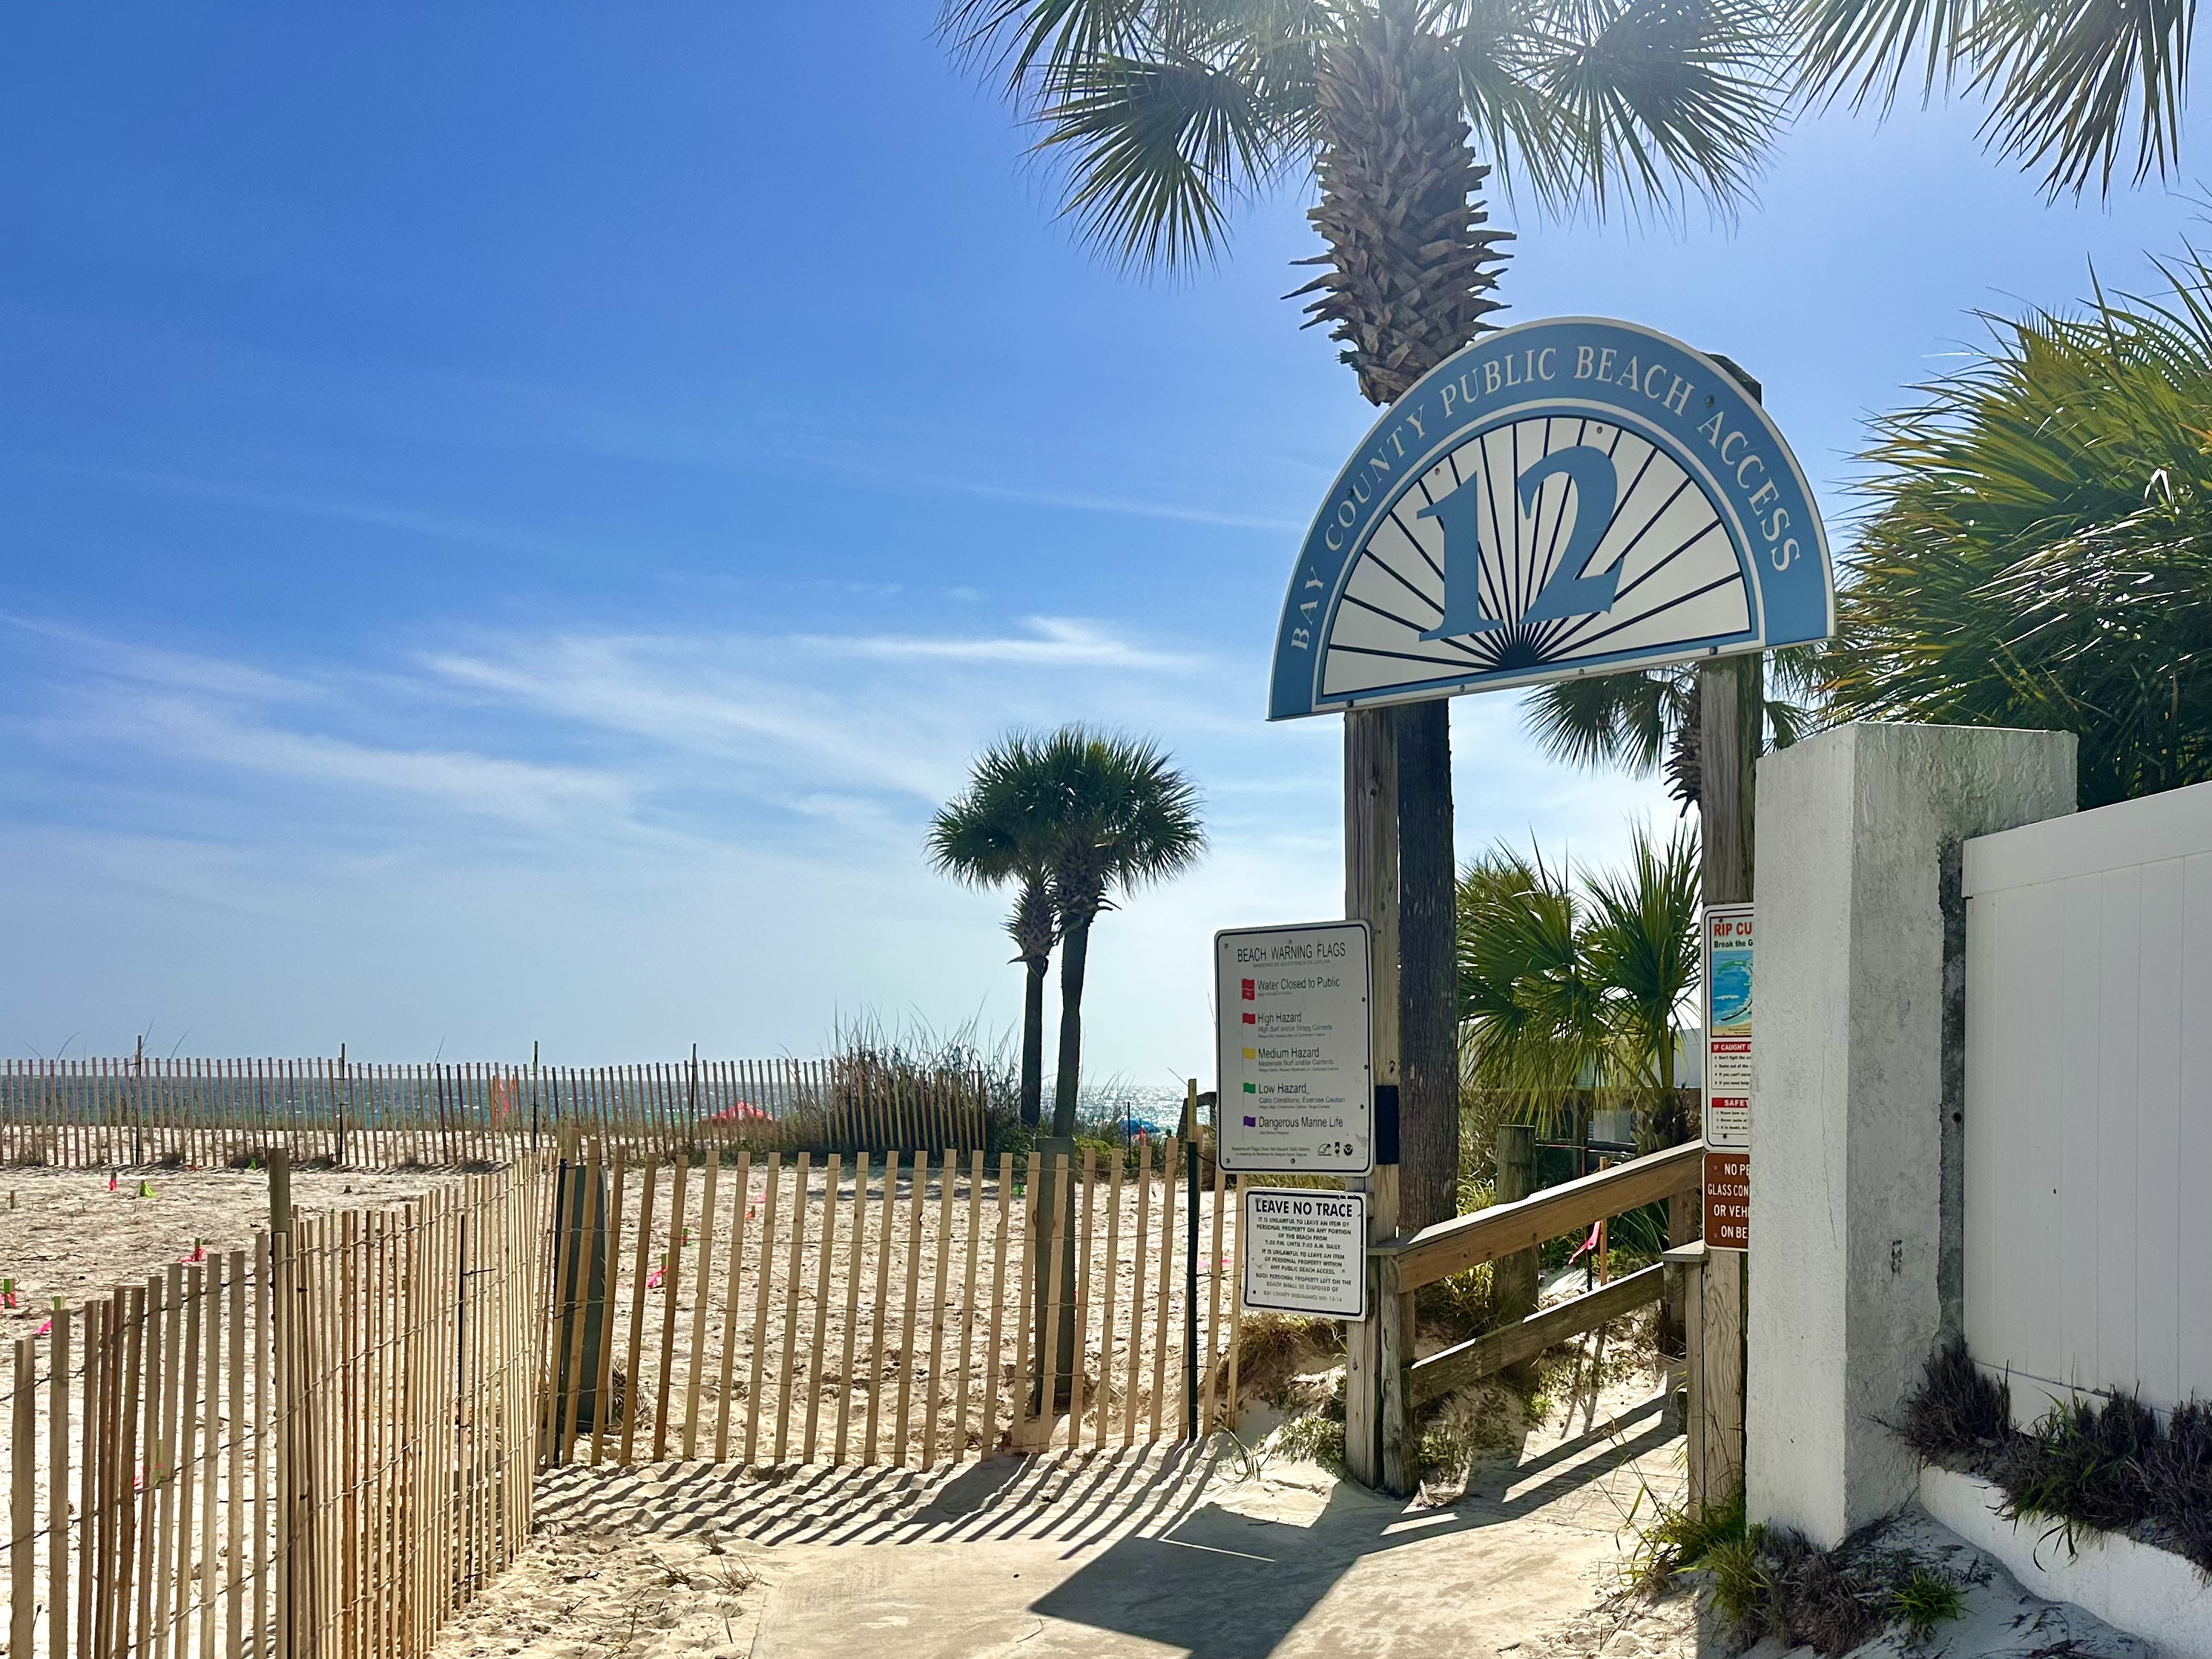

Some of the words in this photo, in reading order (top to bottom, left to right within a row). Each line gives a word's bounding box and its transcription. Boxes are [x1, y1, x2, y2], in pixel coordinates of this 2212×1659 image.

[1291, 565, 1325, 652] BAY
[1325, 404, 1426, 551] COUNTY
[1439, 346, 1556, 418] PUBLIC
[1573, 346, 1695, 416] BEACH
[1696, 410, 1800, 571] ACCESS
[1416, 445, 1625, 643] 12
[1714, 923, 1732, 937] RIP
[1714, 940, 1734, 948] Break
[1237, 947, 1266, 962] BEACH
[1271, 945, 1312, 961] WARNING
[1317, 942, 1346, 958] FLAGS
[1257, 980, 1279, 991] Water
[1281, 978, 1306, 989] Closed
[1309, 979, 1315, 988] to
[1317, 976, 1340, 988] Public
[1258, 1013, 1274, 1026] High
[1276, 1012, 1302, 1022] Hazard
[1258, 1048, 1288, 1059] Medium
[1291, 1046, 1319, 1058] Hazard
[1259, 1083, 1275, 1094] Low
[1277, 1083, 1306, 1094] Hazard
[1259, 1117, 1299, 1130] Dangerous
[1301, 1117, 1327, 1127] Marine
[1329, 1117, 1343, 1127] Life
[1724, 1163, 1737, 1175] NO
[1708, 1183, 1732, 1196] GLASS
[1734, 1184, 1748, 1197] CON
[1256, 1200, 1289, 1214] LEAVE
[1294, 1201, 1312, 1215] NO
[1316, 1203, 1352, 1217] TRACE
[1714, 1204, 1726, 1217] OR
[1721, 1225, 1734, 1238] ON
[1736, 1226, 1748, 1239] BE
